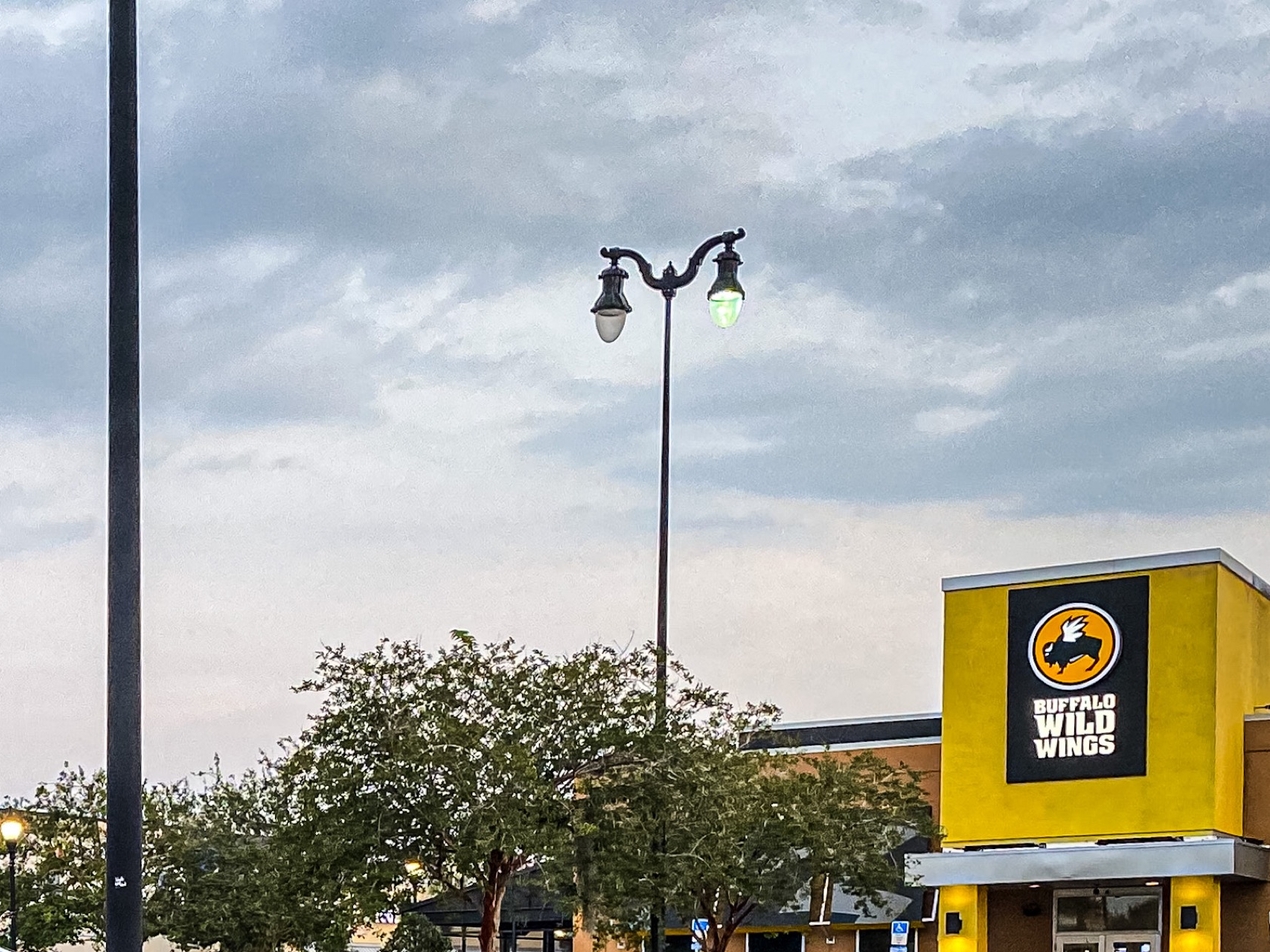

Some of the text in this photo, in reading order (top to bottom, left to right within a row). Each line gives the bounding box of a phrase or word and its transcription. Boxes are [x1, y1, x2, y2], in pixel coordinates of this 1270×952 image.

[1033, 693, 1116, 715] BUFFALO
[1033, 710, 1116, 738] WILD
[1033, 734, 1116, 759] WINGS
